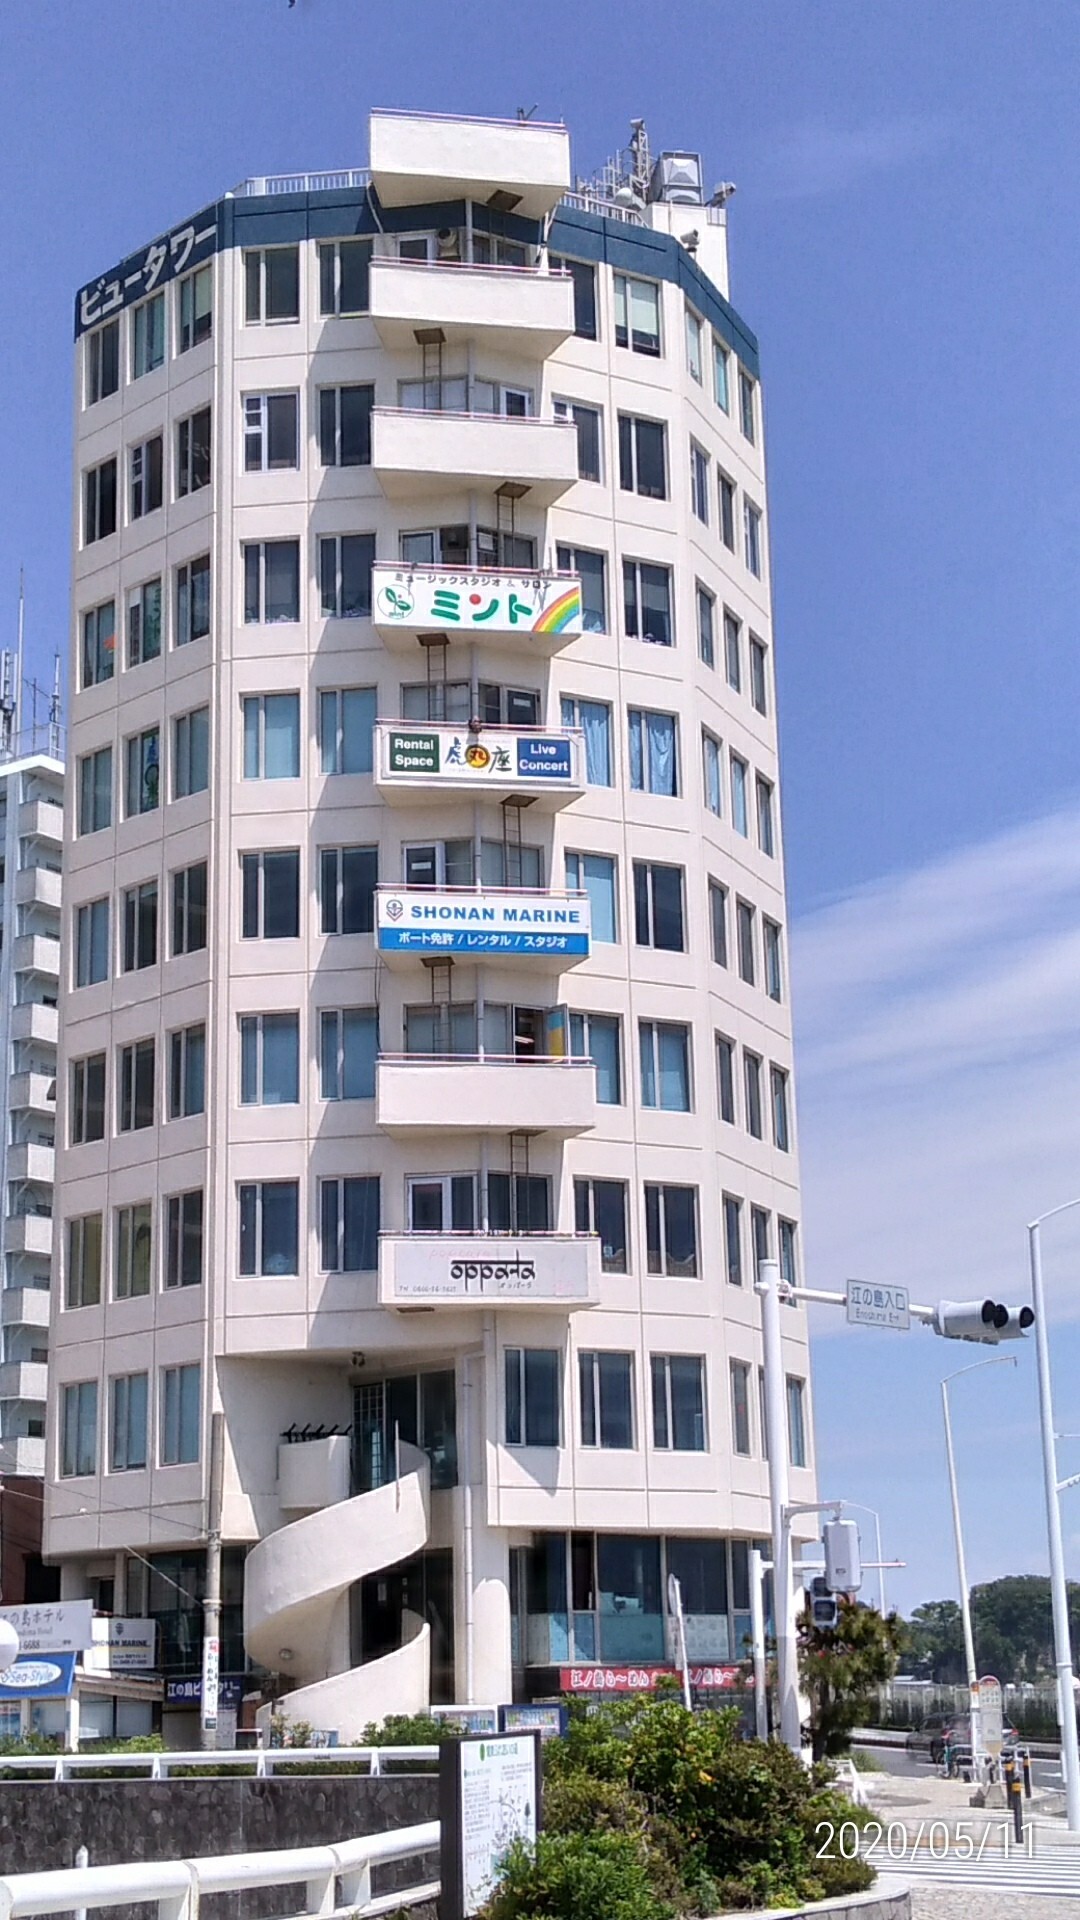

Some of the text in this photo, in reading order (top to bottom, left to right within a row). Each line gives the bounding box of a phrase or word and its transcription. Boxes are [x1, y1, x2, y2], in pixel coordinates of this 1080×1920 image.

[80, 224, 217, 326] ビュータワー
[395, 573, 501, 587] ミュージックスタジオ
[431, 589, 533, 624] ミント
[394, 738, 434, 751] Rental
[530, 743, 557, 755] Live
[394, 755, 434, 768] Space
[519, 759, 569, 772] Concert
[411, 905, 580, 923] SHONAN MARINE
[399, 931, 454, 945] ボート免許
[467, 933, 511, 946] レンタル
[524, 936, 568, 948] スタジオ
[851, 1286, 906, 1310] 江の島入口
